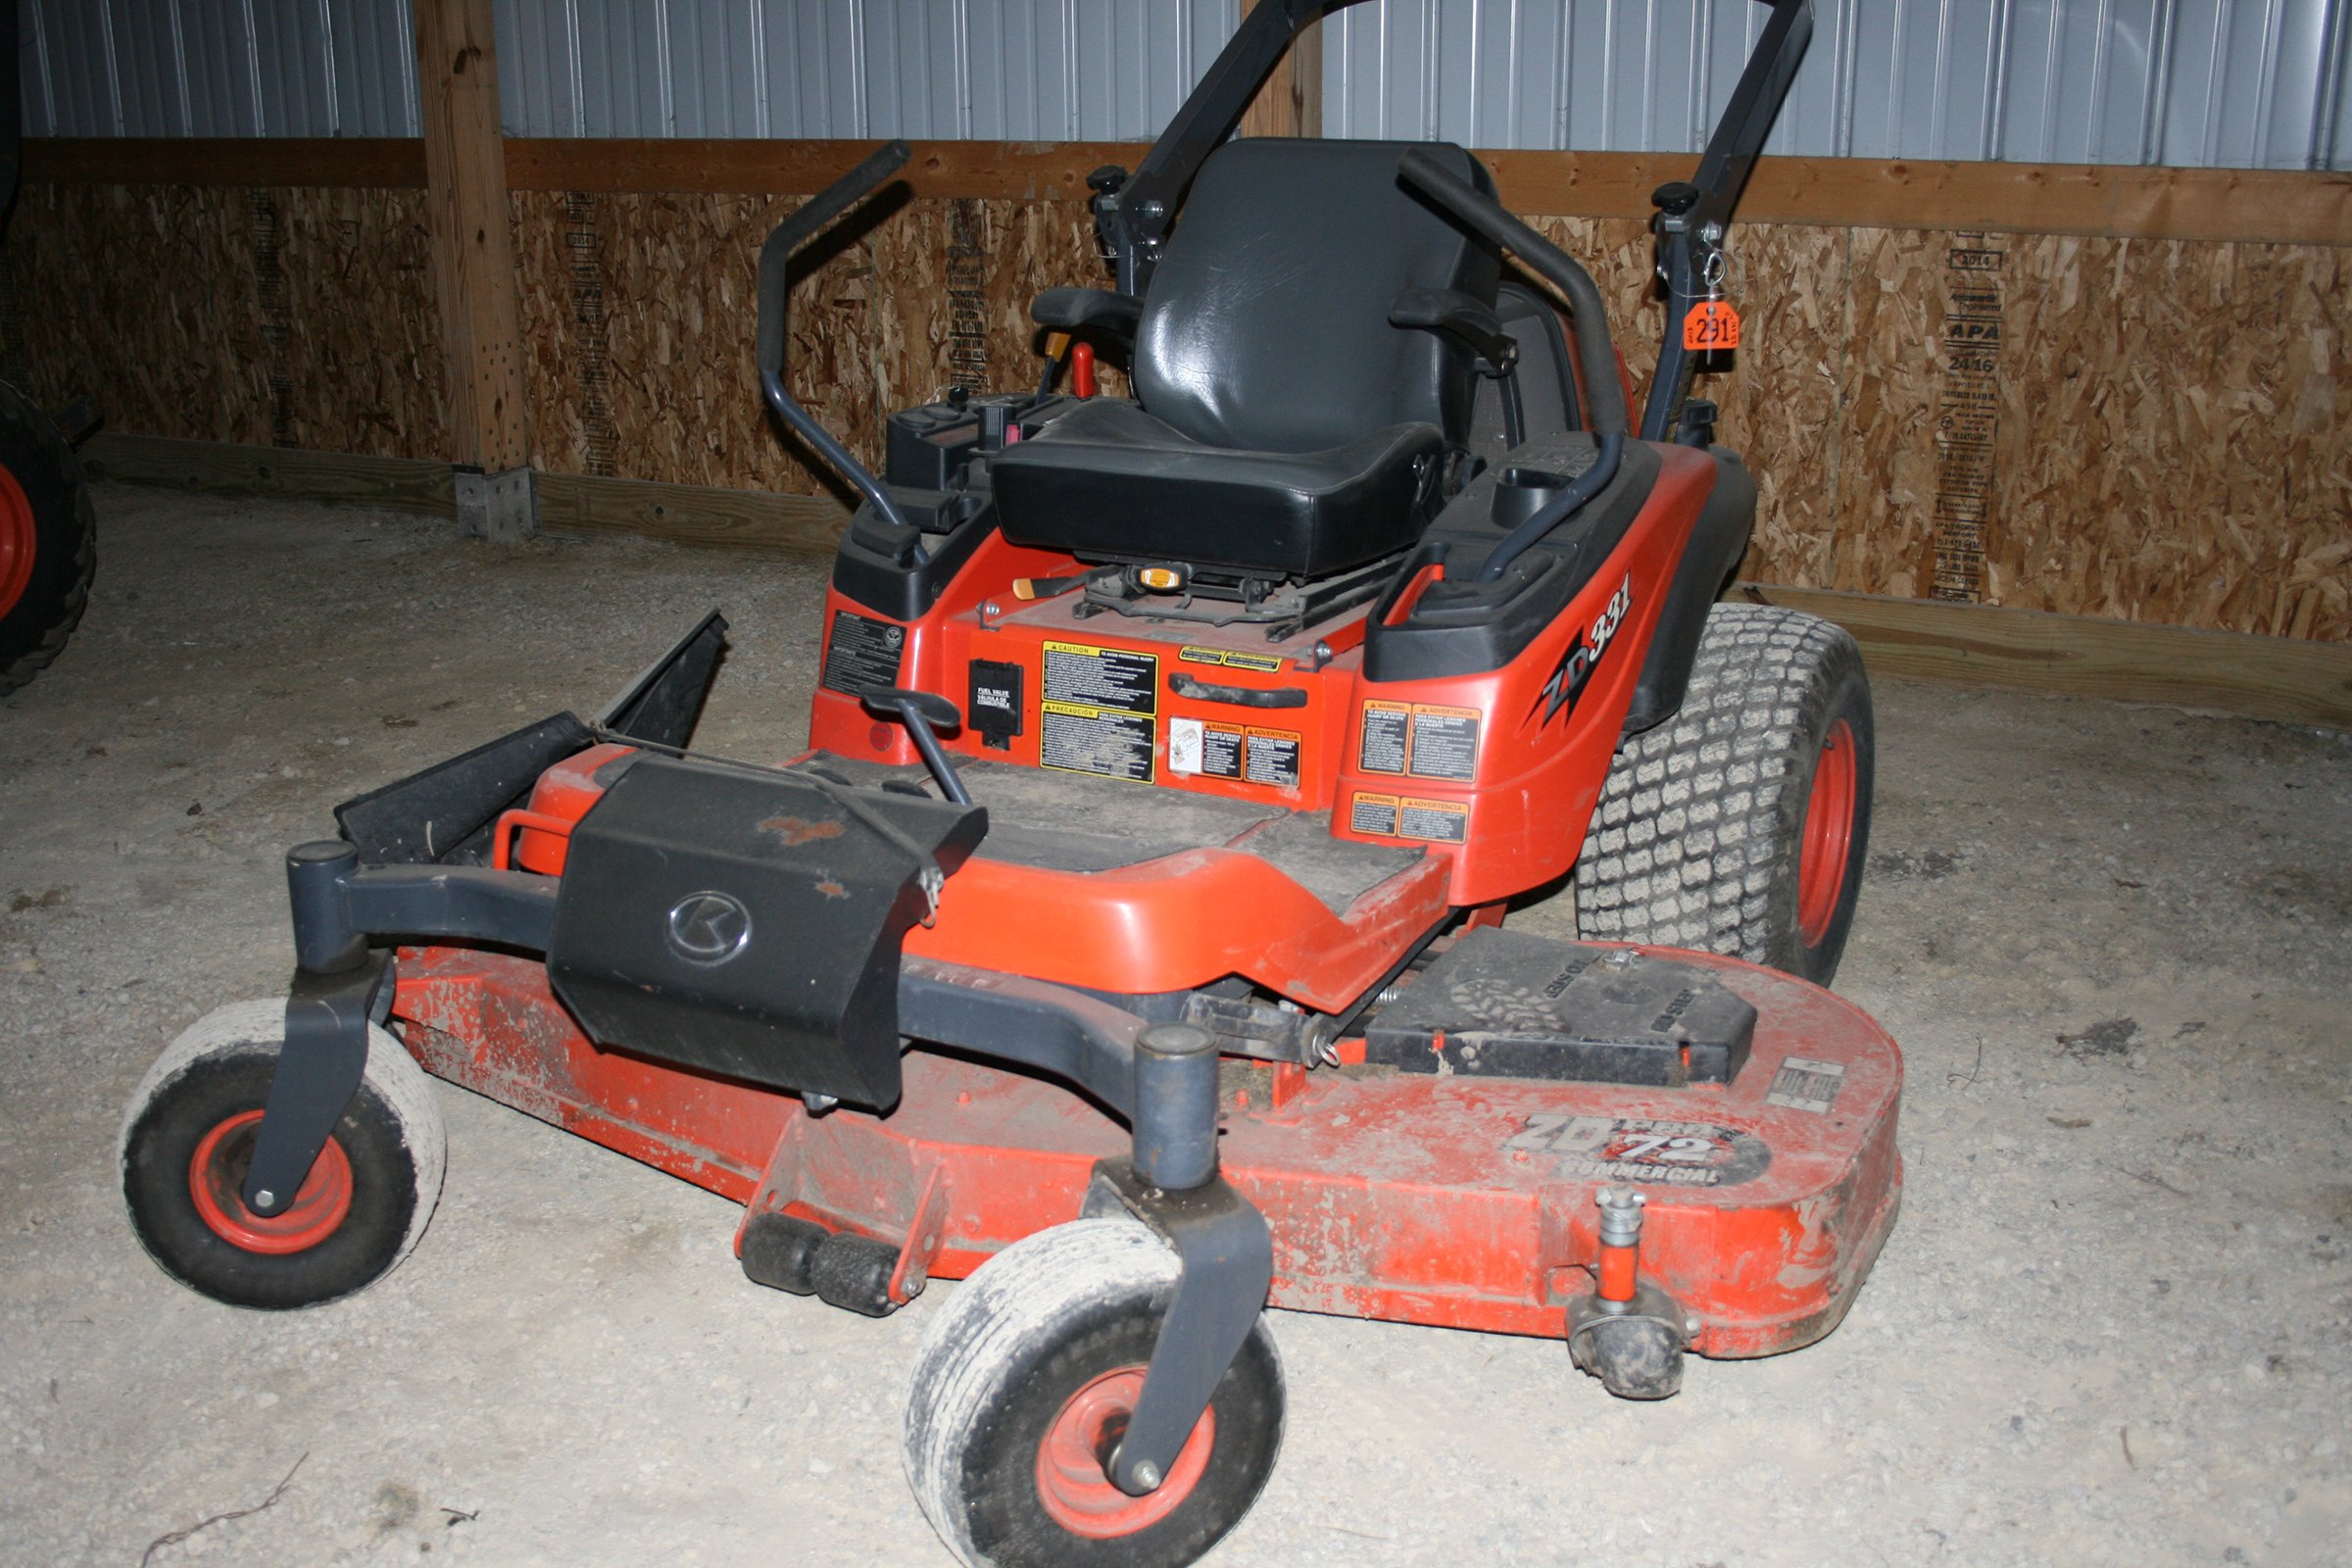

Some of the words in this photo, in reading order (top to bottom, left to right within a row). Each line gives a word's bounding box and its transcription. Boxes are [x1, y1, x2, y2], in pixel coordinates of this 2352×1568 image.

[1961, 254, 1990, 266] 2014
[1696, 318, 1729, 343] 291
[1949, 324, 1999, 339] APA
[1057, 644, 1089, 654] CAUTION
[977, 700, 1010, 709] COMBUSTIBLE
[1052, 705, 1094, 717] PRECAUCIÓN
[1210, 723, 1240, 732] WARNING
[1253, 729, 1298, 740] ADVERTENCIA
[1363, 795, 1395, 804] WARNING
[1414, 801, 1462, 810] ADVERTENCIA
[1503, 1113, 1616, 1152] ZD
[1619, 1134, 1713, 1162] 72
[1560, 1159, 1720, 1184] COMMERCIAL
